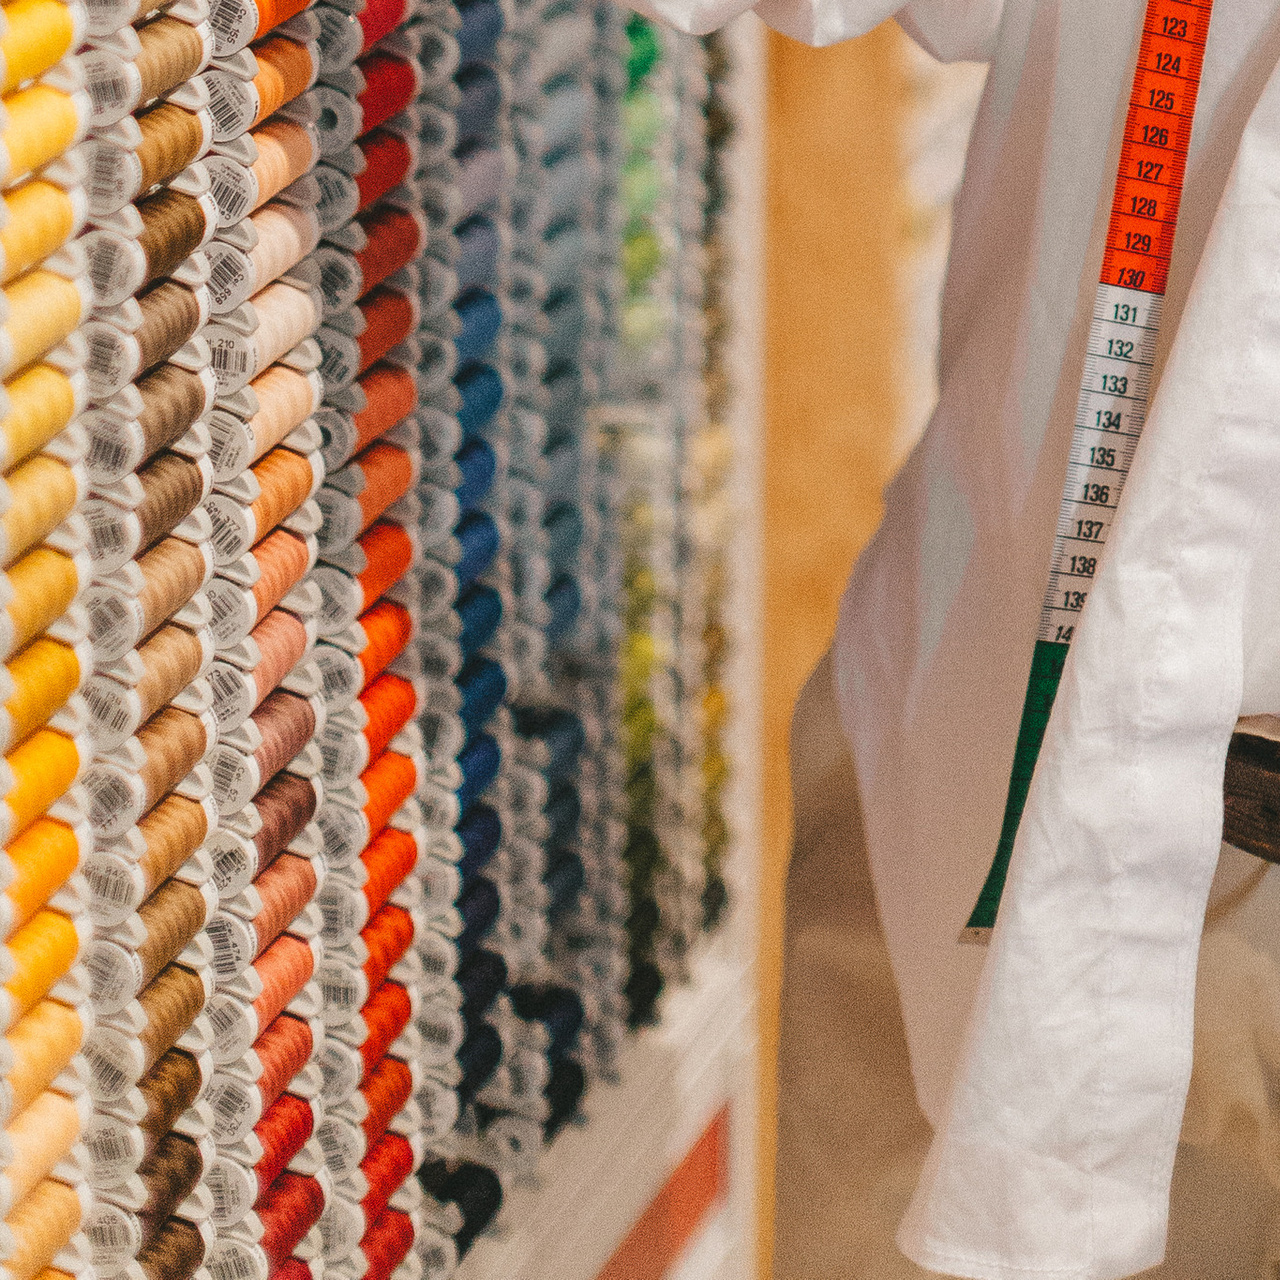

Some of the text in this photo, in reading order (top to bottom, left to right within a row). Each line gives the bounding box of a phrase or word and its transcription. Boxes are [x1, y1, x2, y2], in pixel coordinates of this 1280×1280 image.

[225, 28, 239, 45] 155
[1162, 16, 1188, 38] 123
[1156, 52, 1181, 74] 124
[1149, 88, 1175, 111] 125
[1142, 124, 1169, 146] 126
[1137, 160, 1164, 181] 127
[1131, 196, 1157, 217] 128
[1125, 231, 1151, 253] 129
[1116, 267, 1145, 289] 130
[1113, 303, 1138, 323] 131
[218, 338, 235, 349] 210
[1107, 338, 1134, 360] 132
[1102, 374, 1128, 395] 133
[1096, 409, 1122, 431] 134
[1090, 446, 1116, 467] 135
[1083, 483, 1110, 503] 136
[1076, 520, 1104, 539] 137
[1069, 556, 1097, 575] 138
[1055, 625, 1075, 642] 14
